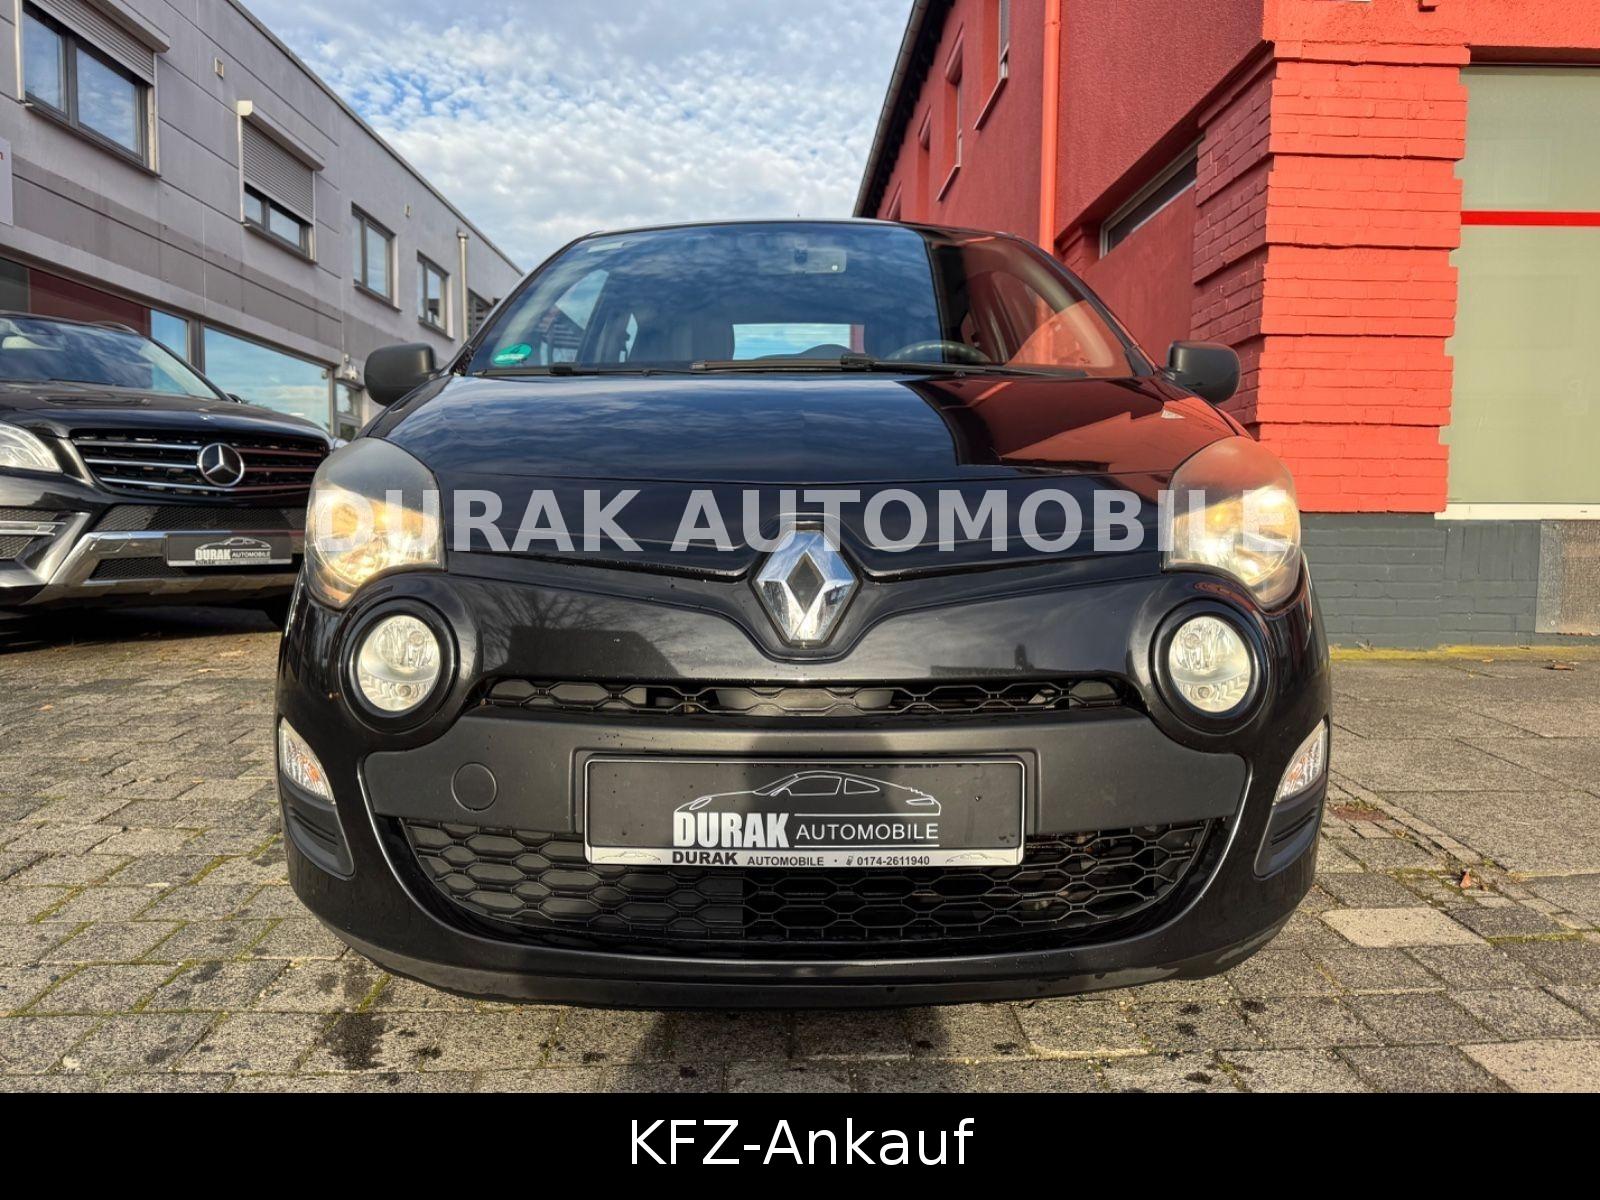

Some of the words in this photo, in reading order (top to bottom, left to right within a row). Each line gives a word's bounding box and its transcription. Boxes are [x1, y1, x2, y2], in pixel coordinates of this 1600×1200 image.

[195, 549, 231, 560] DURAK
[232, 551, 270, 559] AUTOMOBILE
[673, 812, 789, 848] DURAK
[796, 823, 939, 840] AUTOMOBILE
[672, 851, 738, 865] DURAK
[747, 856, 824, 866] AUTOMOBILE
[857, 856, 930, 867] 0174-2611940
